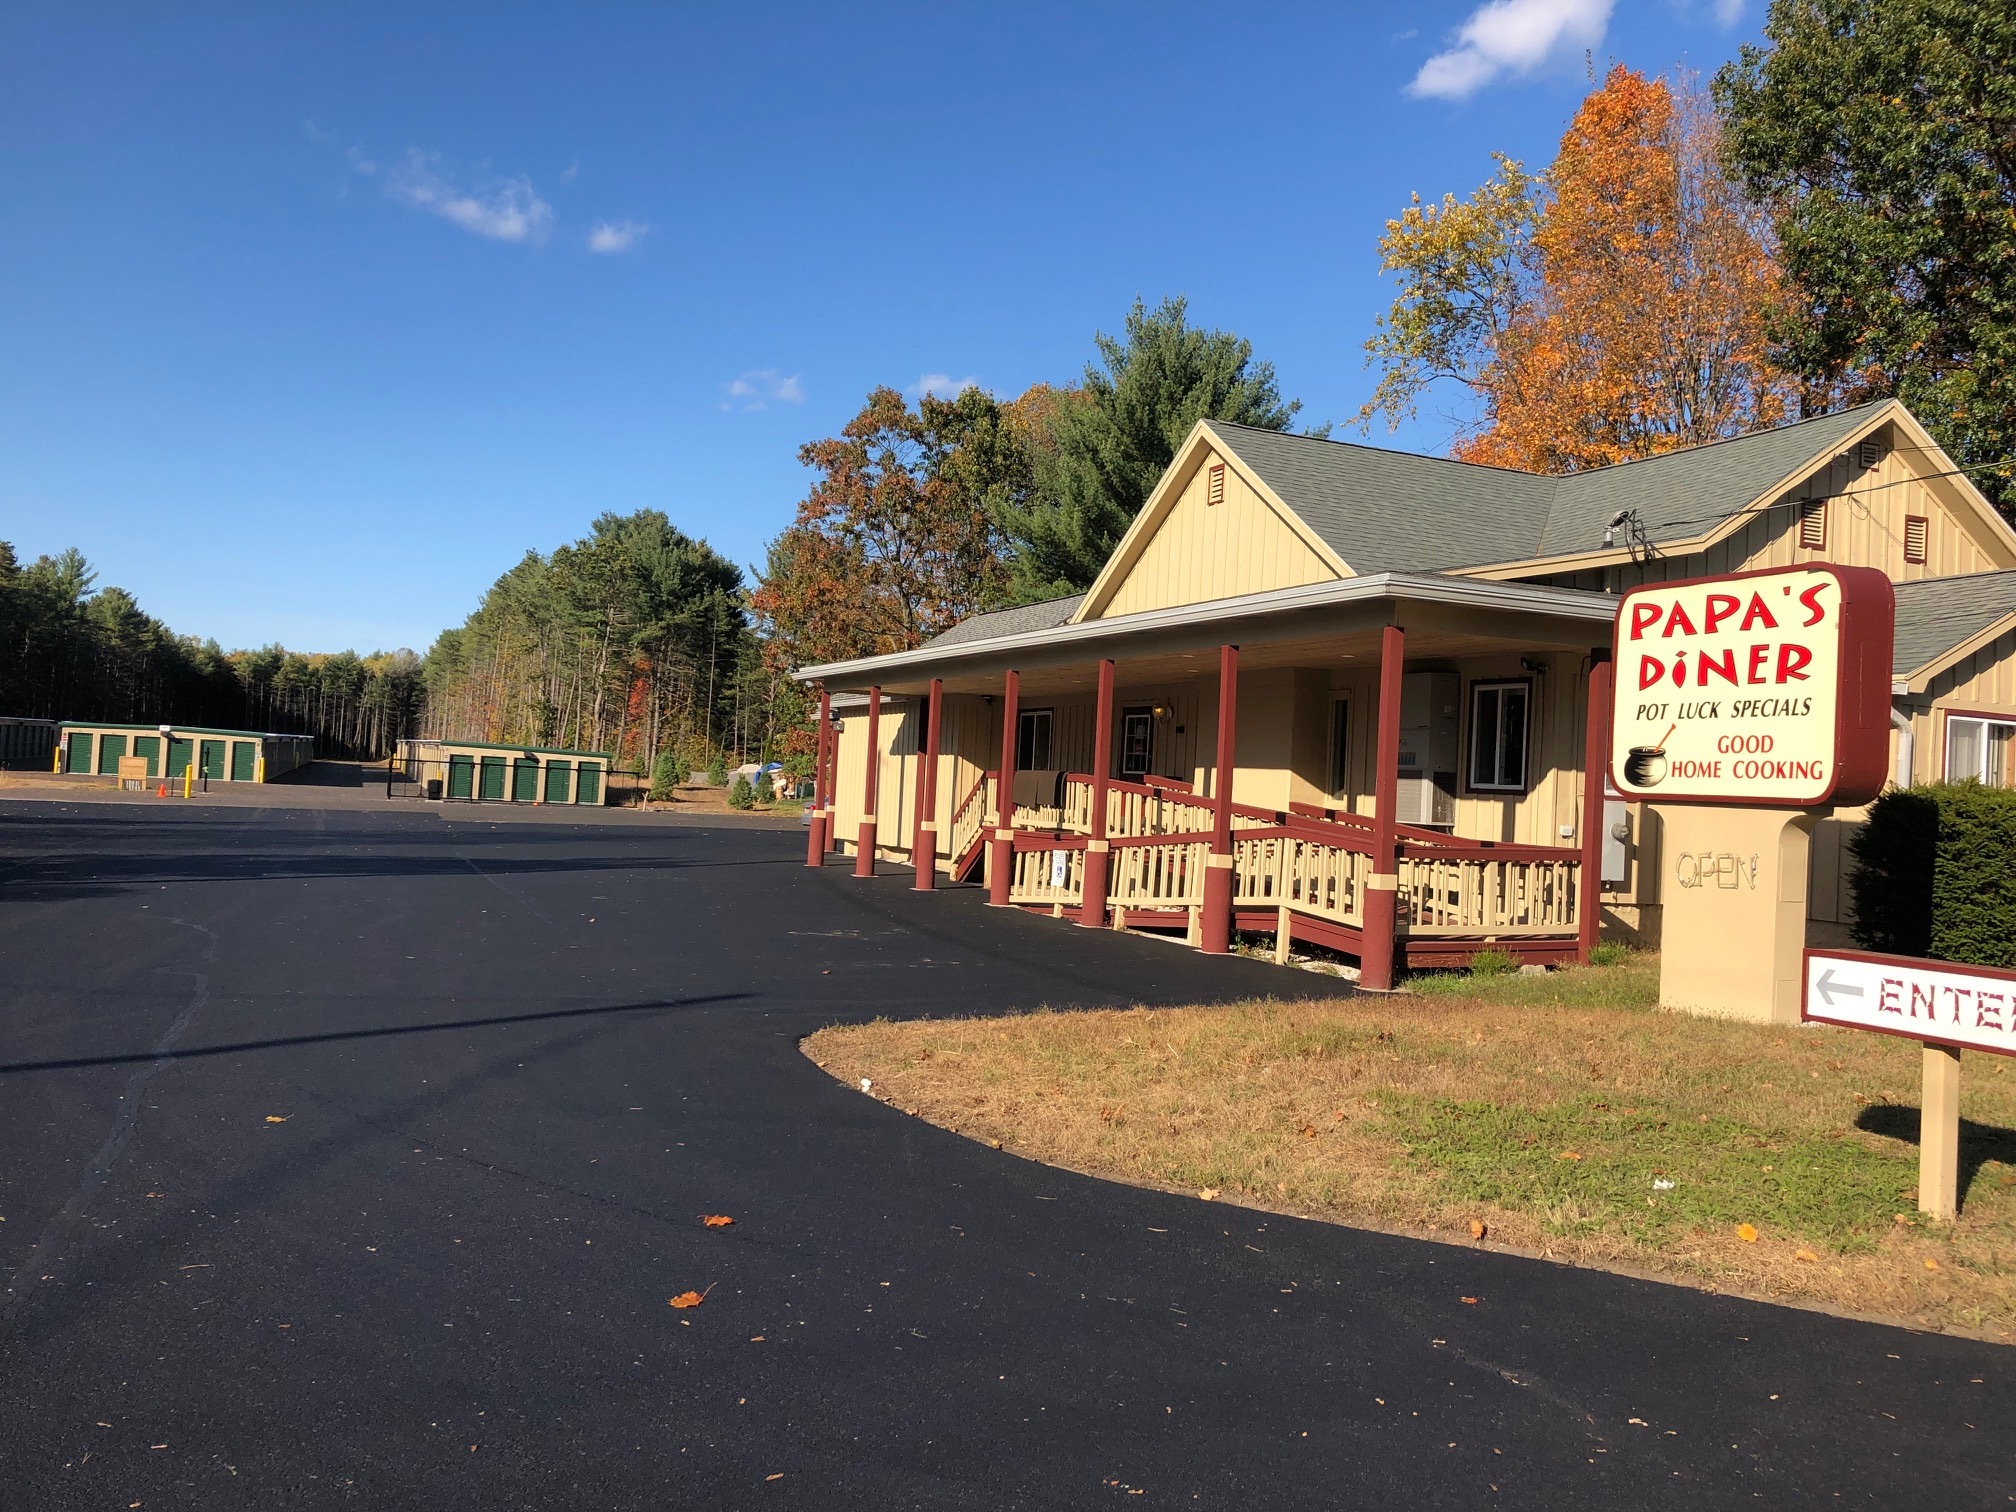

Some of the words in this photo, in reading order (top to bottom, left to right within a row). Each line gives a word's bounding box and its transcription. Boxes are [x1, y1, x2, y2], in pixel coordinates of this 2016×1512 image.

[1630, 582, 1832, 641] PAPA'S
[1636, 703, 1670, 721] POT
[1677, 701, 1722, 720] LUCK
[1730, 697, 1812, 719] SPECIALS
[1717, 735, 1774, 754] GOOD
[1671, 760, 1722, 779] HOME
[1732, 760, 1823, 780] COOKING
[1676, 851, 1759, 890] OPEN
[1879, 977, 2016, 1034] ENTE
